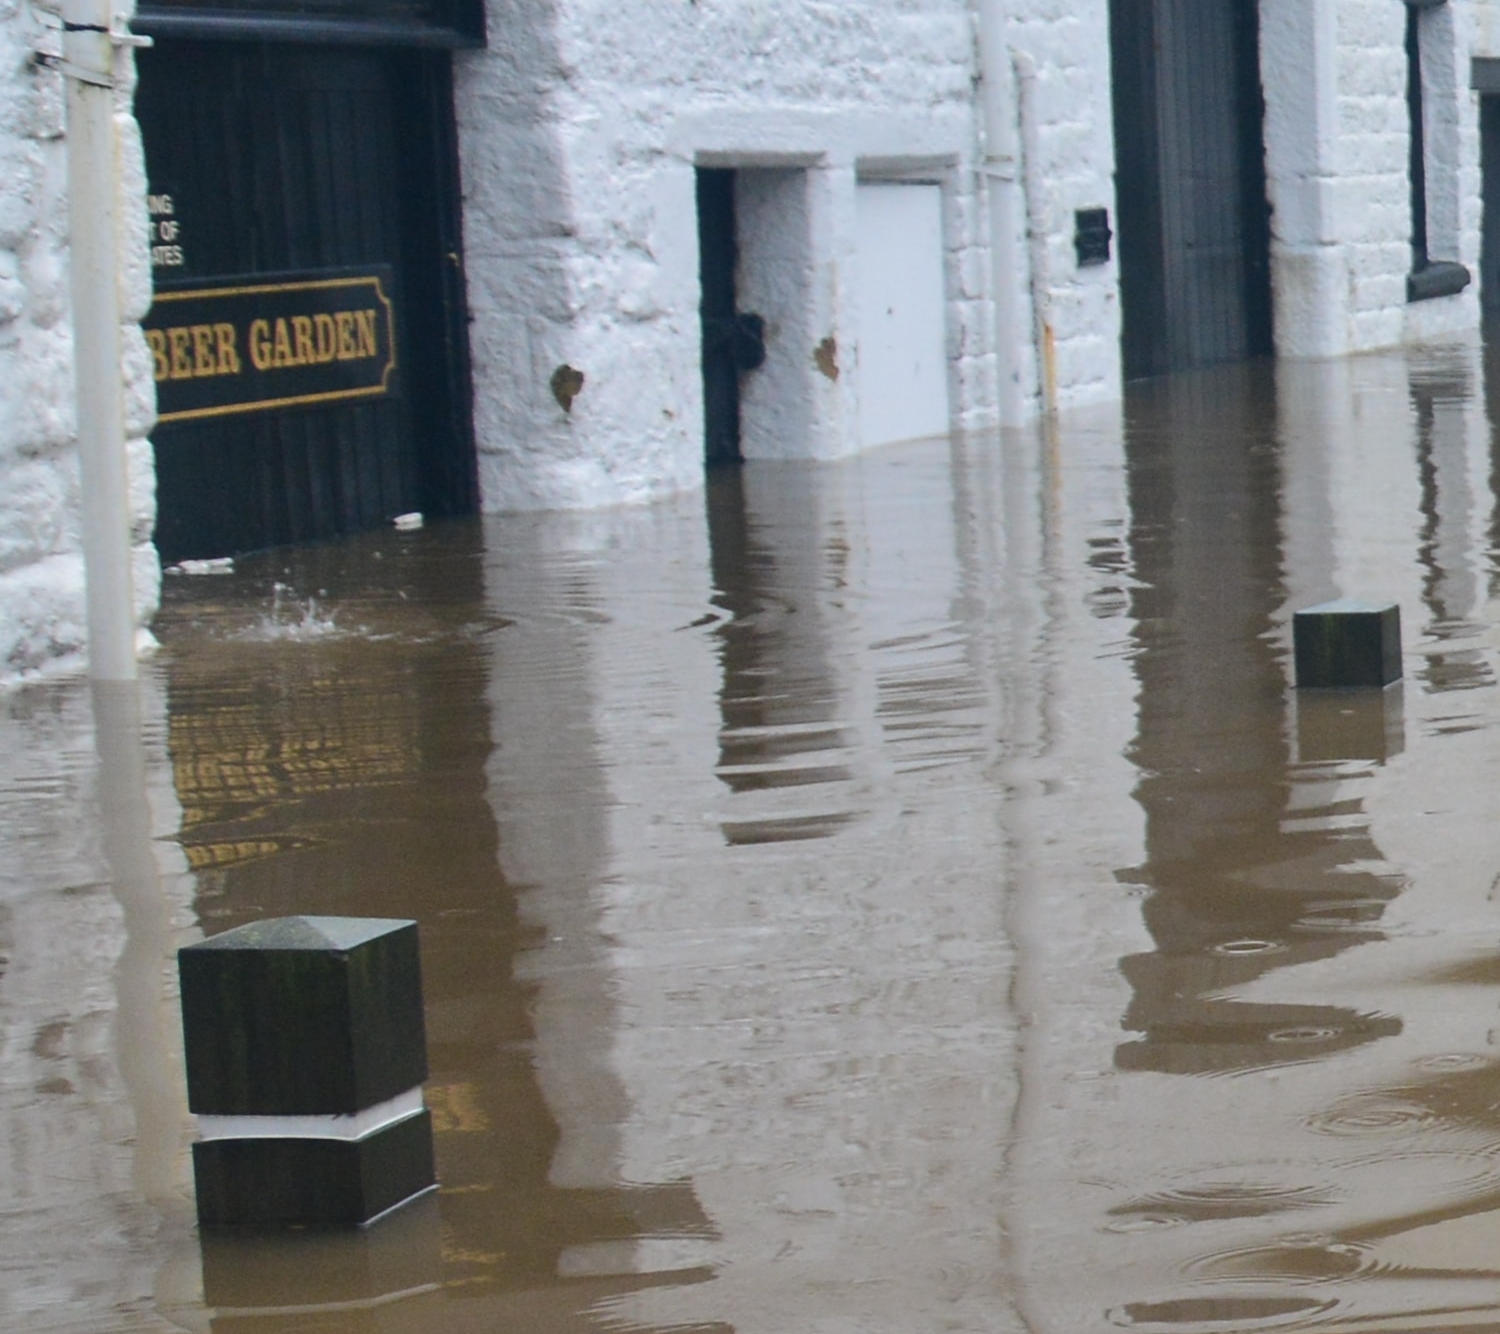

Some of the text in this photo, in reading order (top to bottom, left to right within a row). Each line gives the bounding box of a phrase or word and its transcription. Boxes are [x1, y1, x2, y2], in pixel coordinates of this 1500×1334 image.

[160, 220, 180, 242] OF
[145, 309, 377, 382] BEER GARDEN
